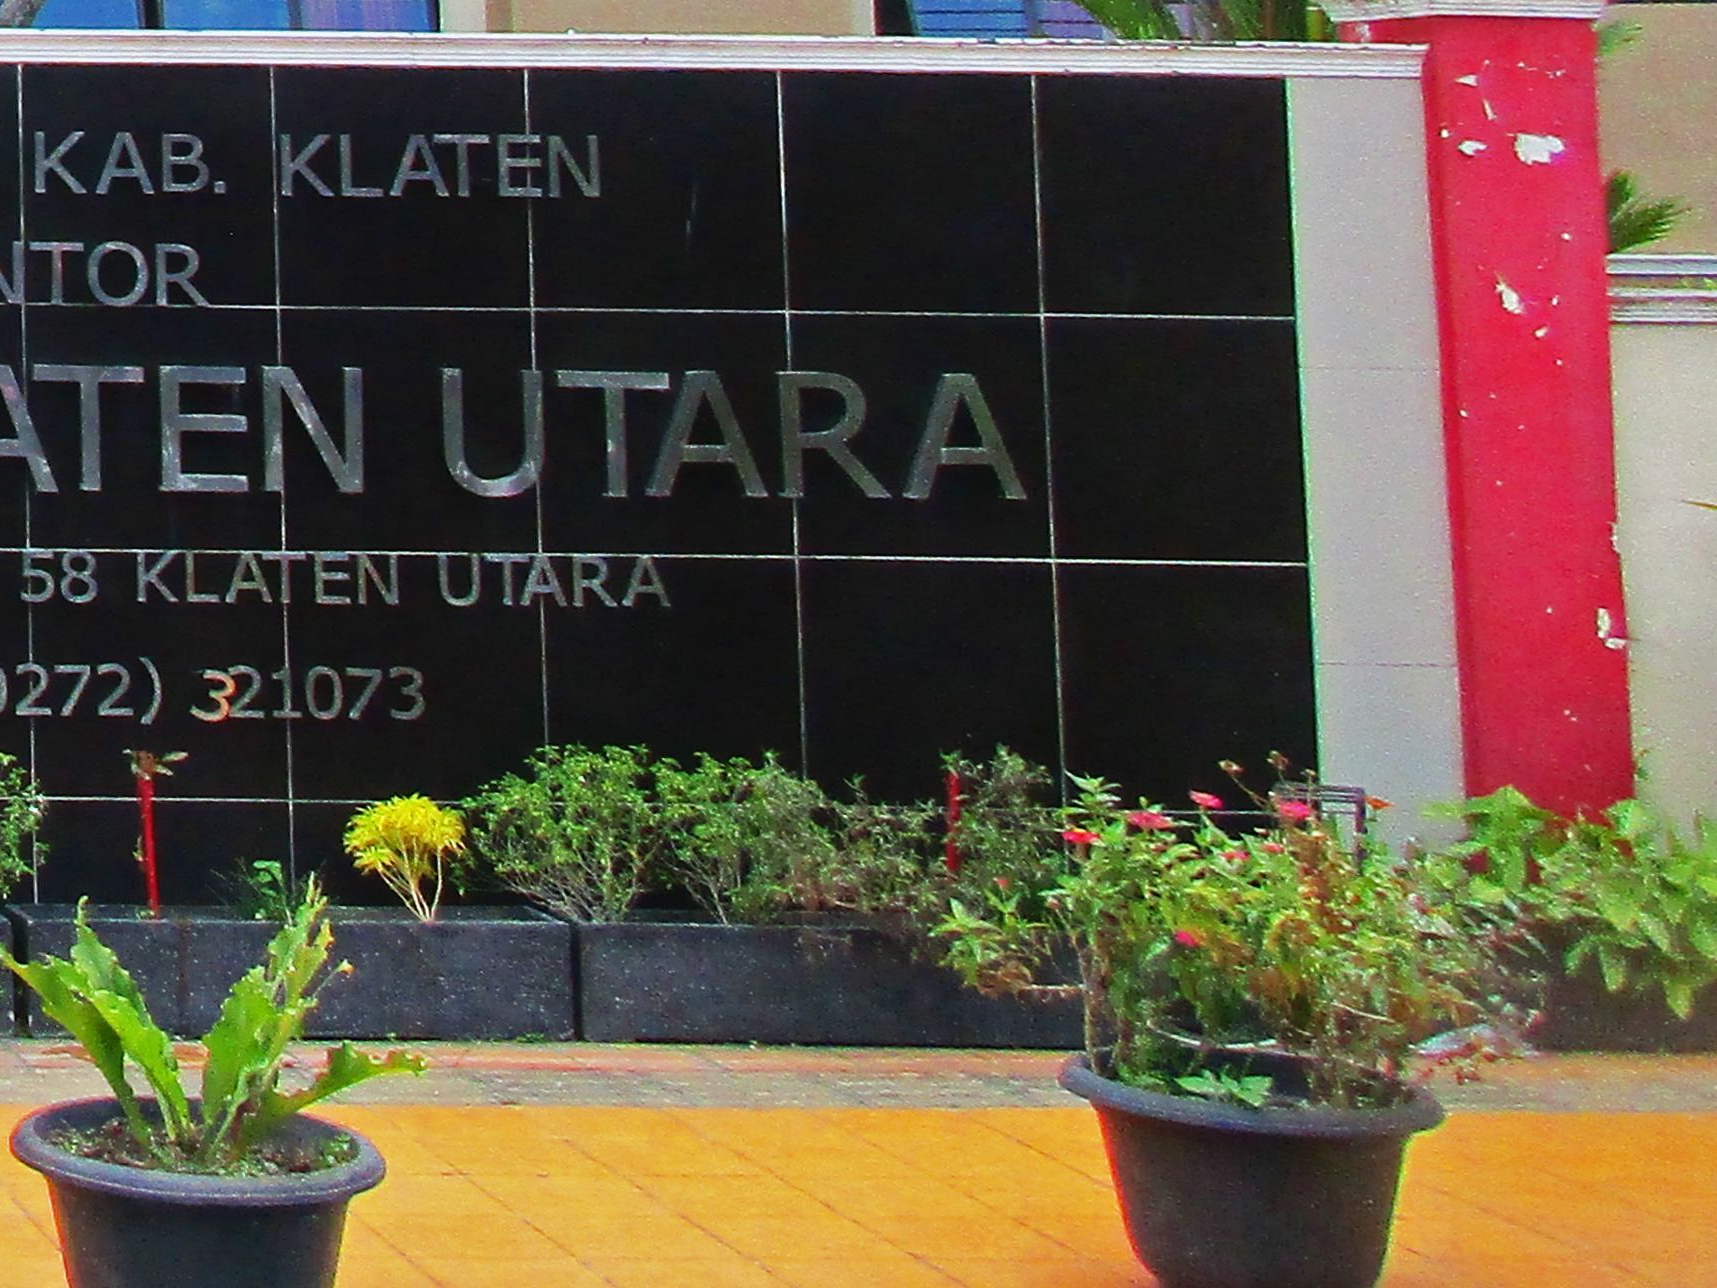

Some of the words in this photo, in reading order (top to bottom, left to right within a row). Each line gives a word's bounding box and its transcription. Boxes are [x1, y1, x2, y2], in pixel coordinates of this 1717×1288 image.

[33, 131, 227, 195] KAB.
[279, 134, 602, 198] KLATEN
[440, 367, 1027, 501] UTARA
[20, 551, 99, 604] 58
[136, 551, 401, 606] KLATEN
[438, 554, 672, 608] UTARA
[191, 665, 426, 722] 321073
